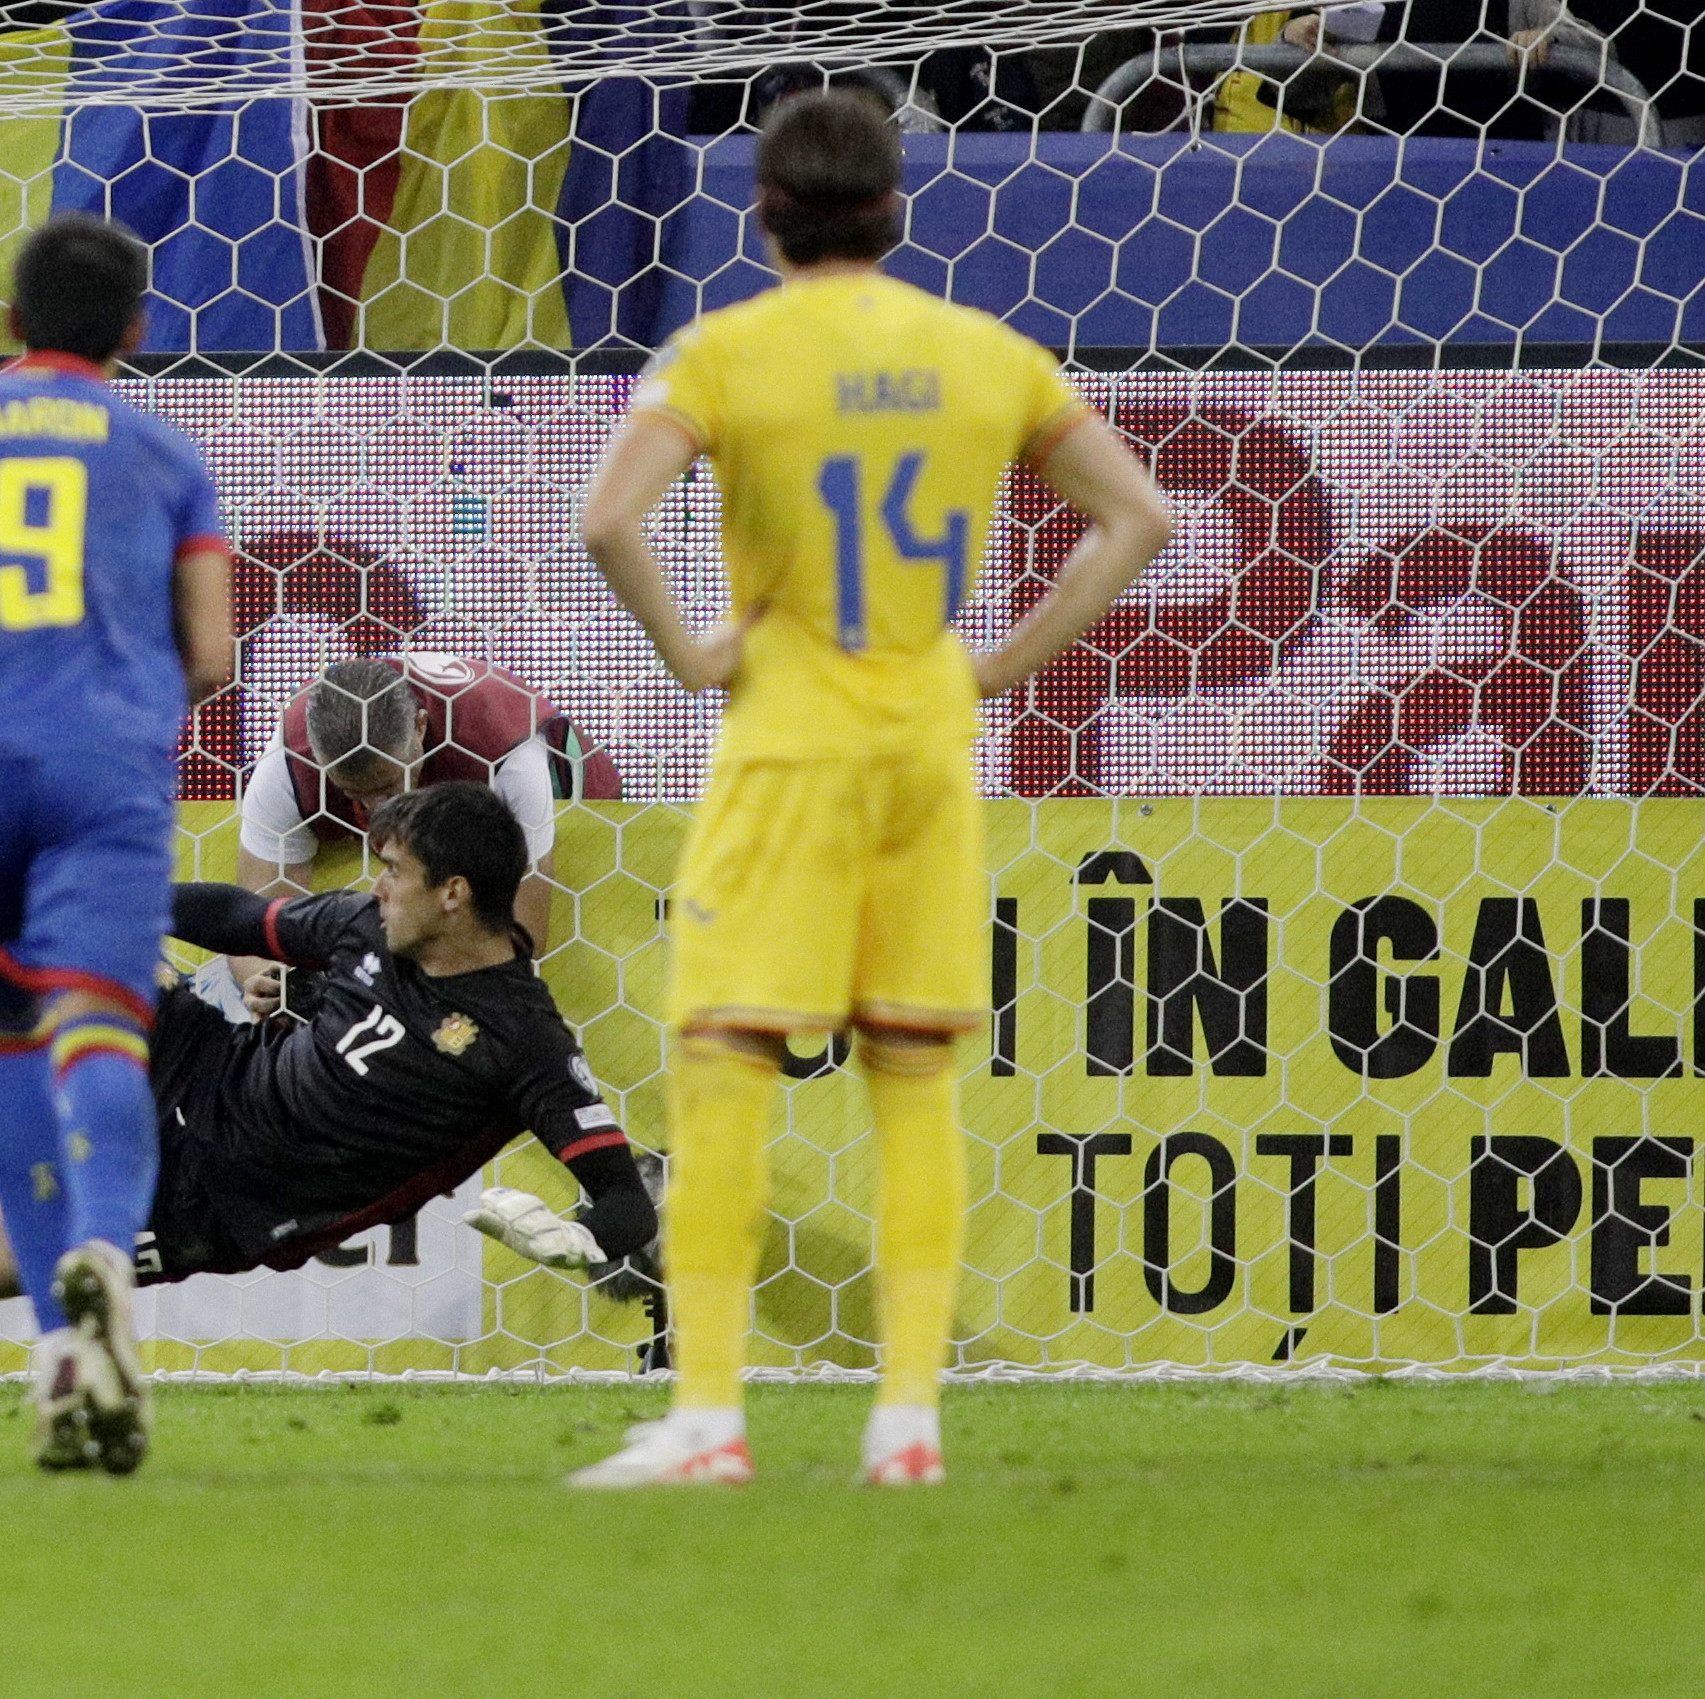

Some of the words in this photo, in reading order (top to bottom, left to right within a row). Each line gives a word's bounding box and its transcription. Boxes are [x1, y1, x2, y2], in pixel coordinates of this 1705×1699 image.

[836, 370, 941, 412] HAGI
[816, 450, 968, 652] 14
[336, 1004, 406, 1077] 12
[1068, 851, 1270, 1078] ÎN
[1329, 895, 1705, 1079] GAL
[1470, 1134, 1705, 1315] PE
